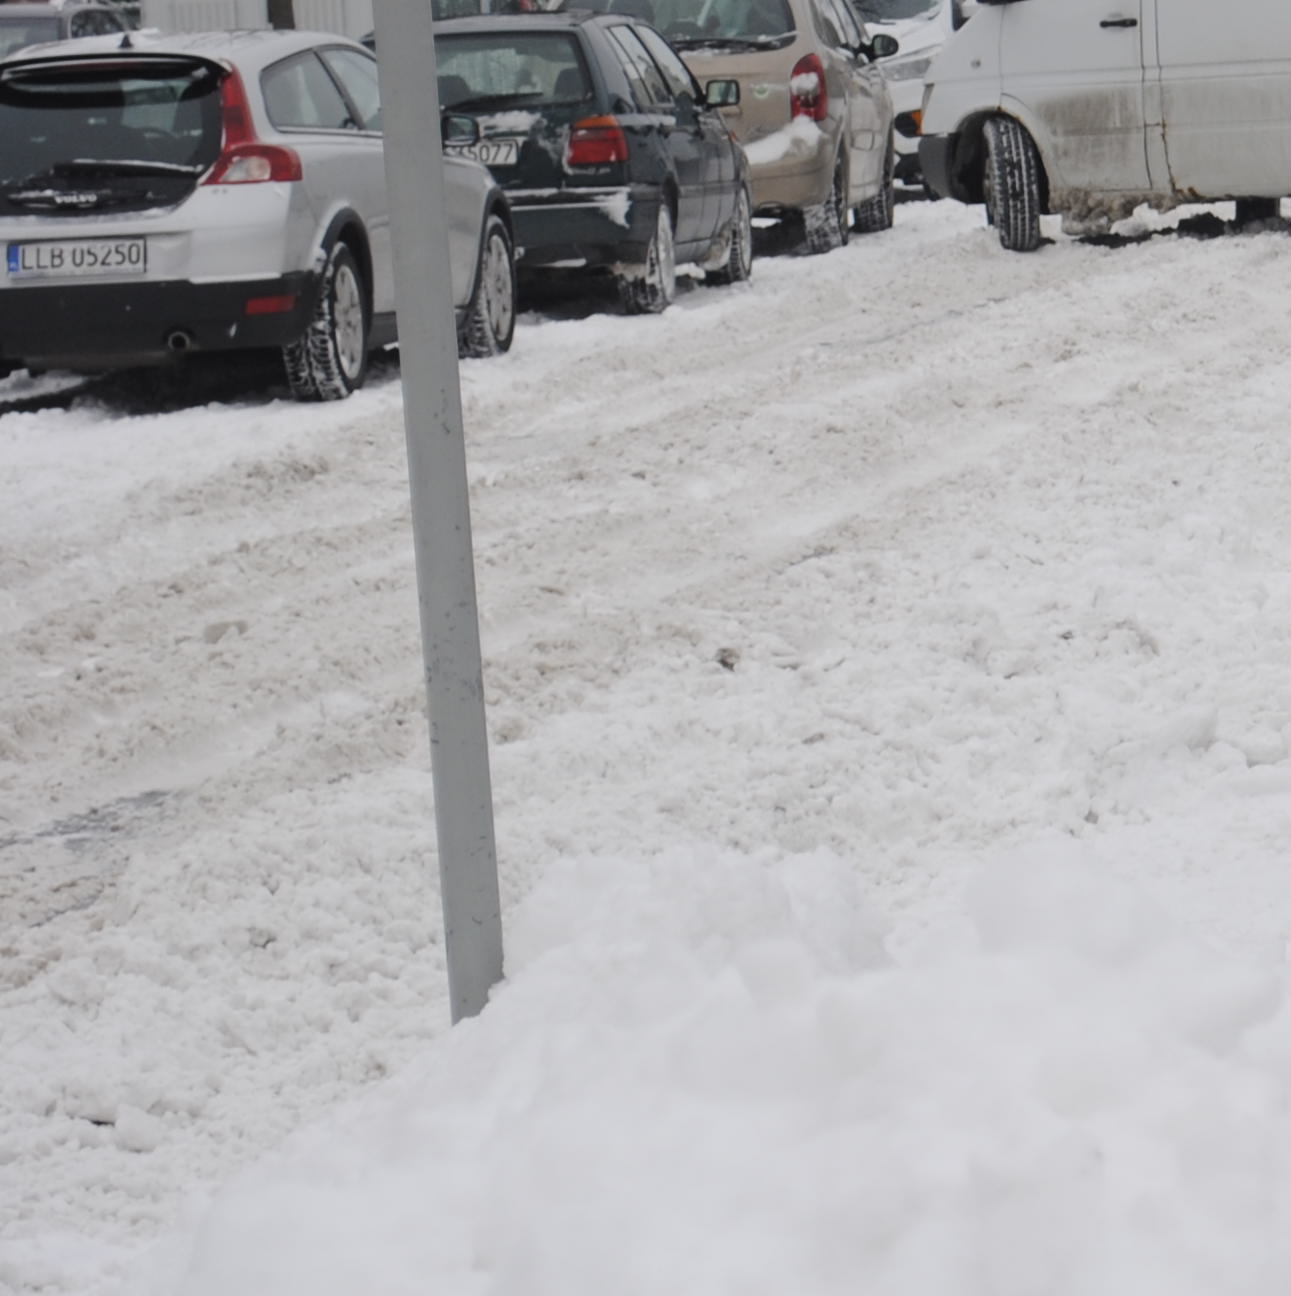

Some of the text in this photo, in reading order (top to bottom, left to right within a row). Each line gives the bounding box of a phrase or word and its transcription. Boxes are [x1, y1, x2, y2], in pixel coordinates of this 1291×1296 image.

[54, 193, 98, 204] VOLVO
[21, 242, 141, 270] LLB 05250
